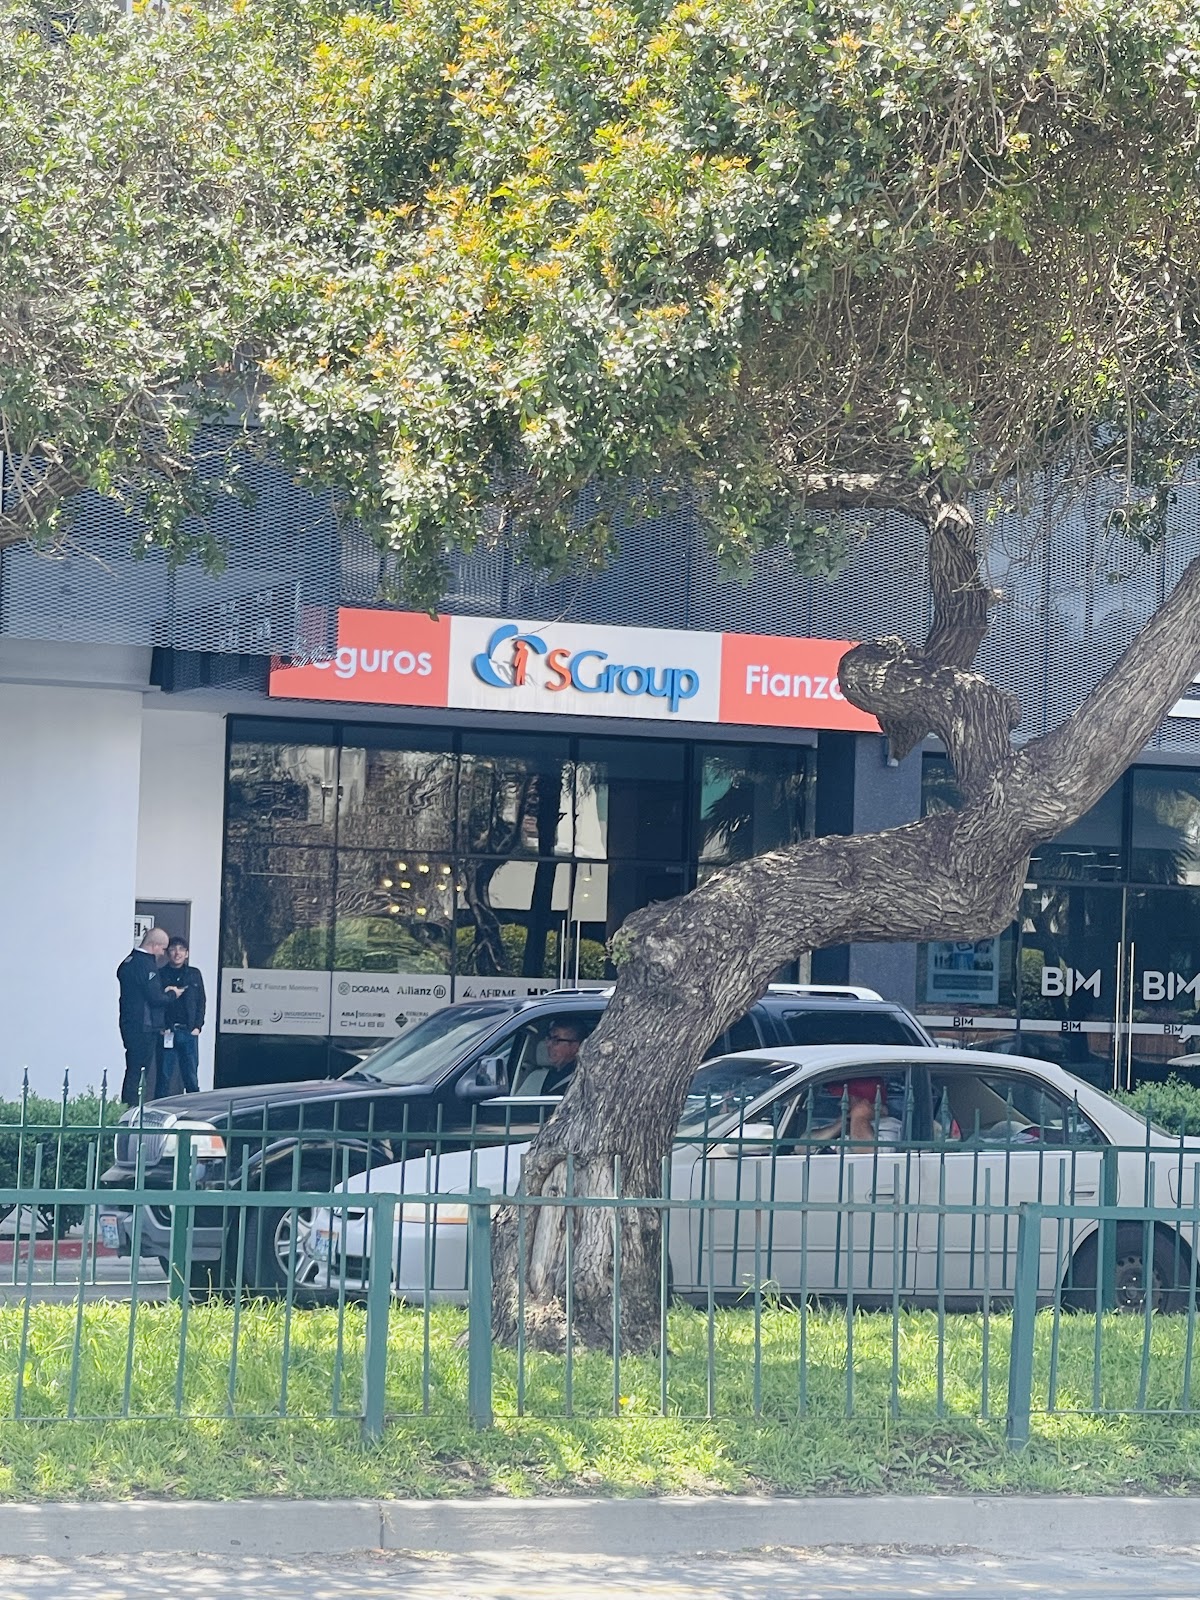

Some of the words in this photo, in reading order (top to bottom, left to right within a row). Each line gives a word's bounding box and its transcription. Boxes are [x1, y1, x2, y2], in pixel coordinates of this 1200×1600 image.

[1041, 966, 1101, 998] BIM
[1143, 970, 1200, 1001] BIM
[351, 985, 390, 994] DORAMA
[397, 986, 432, 996] Allianz
[223, 1018, 263, 1026] MAPFRE
[340, 1020, 385, 1028] CHUBB
[953, 1016, 974, 1027] BIM
[1061, 1021, 1082, 1032] BIM
[1163, 1024, 1184, 1035] BIM
